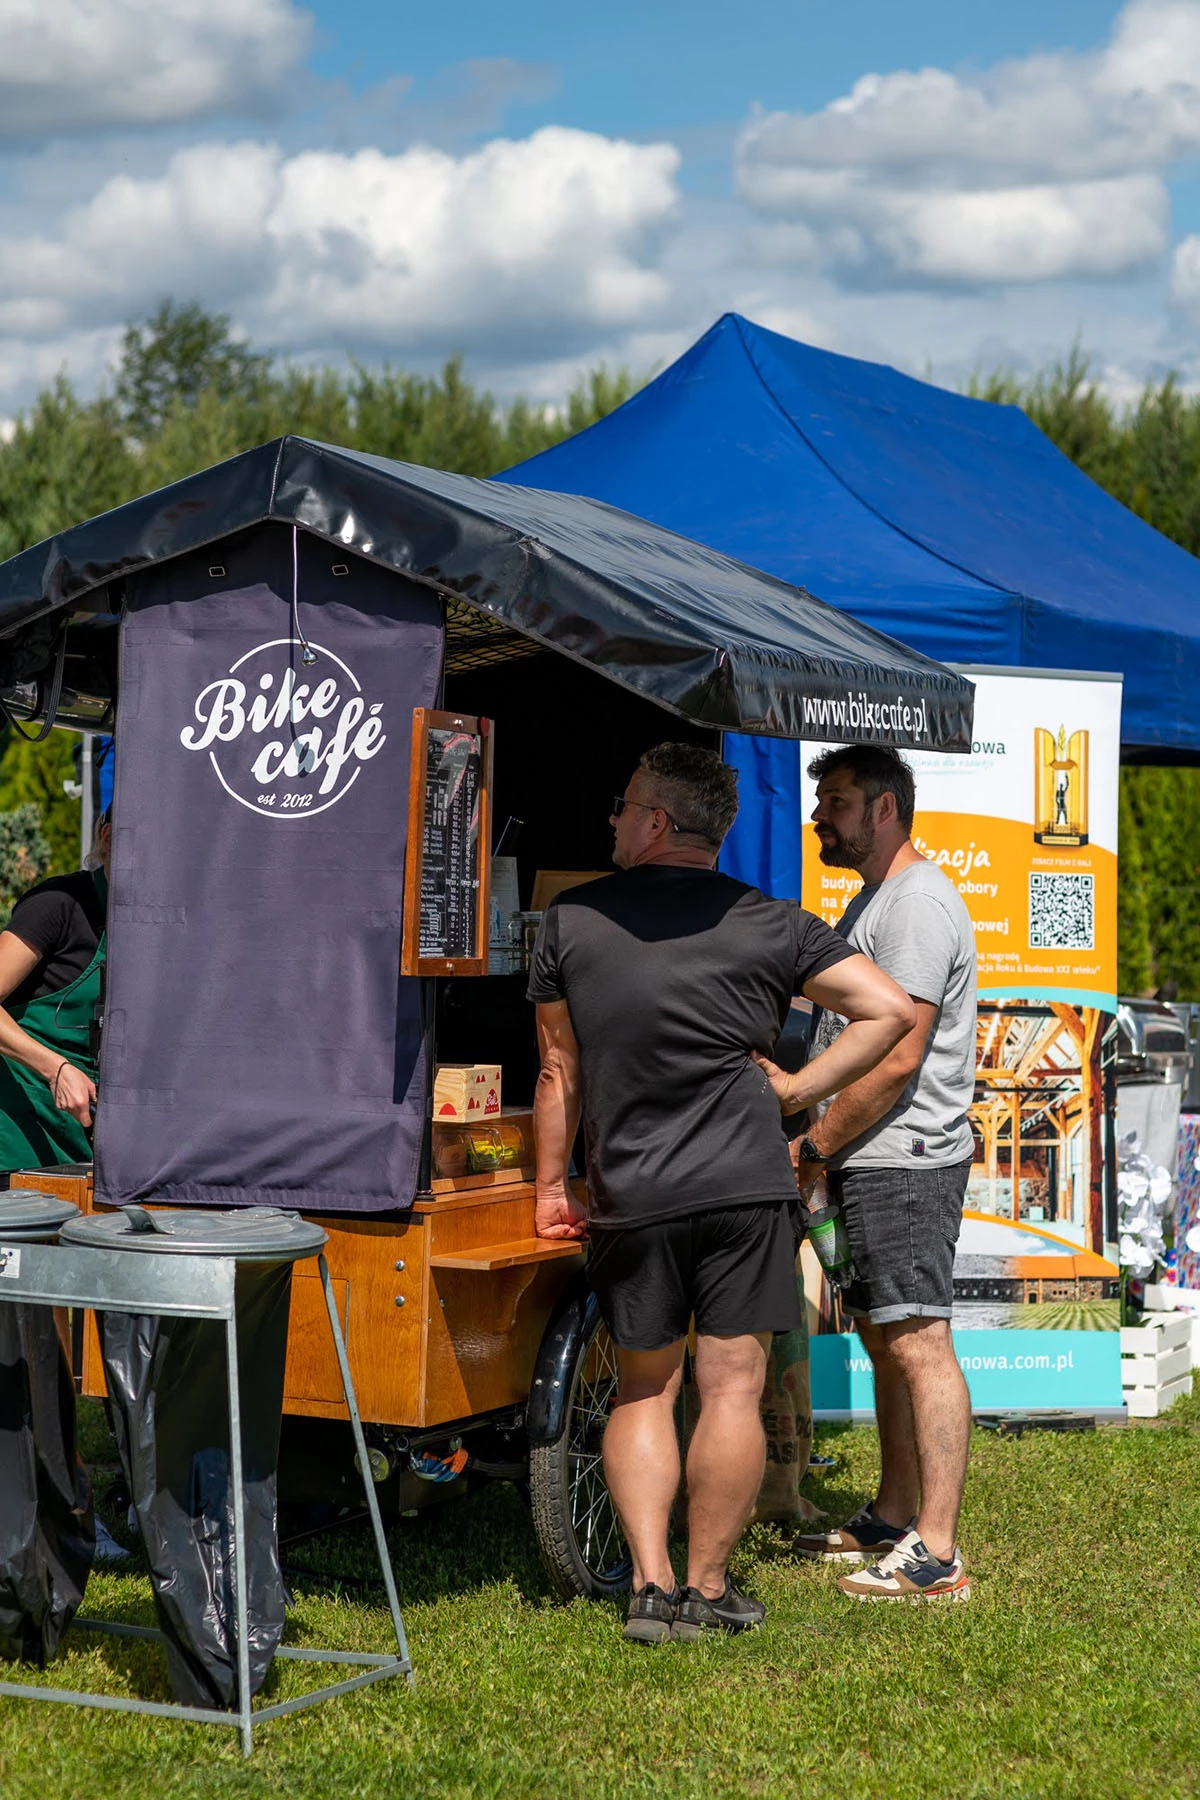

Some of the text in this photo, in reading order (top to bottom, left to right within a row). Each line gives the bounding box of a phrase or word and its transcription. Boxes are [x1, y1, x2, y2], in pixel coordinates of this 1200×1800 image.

[180, 667, 340, 750] Bike
[803, 692, 928, 741] www.bikecafe.pl
[251, 697, 387, 795] café
[971, 741, 1006, 755] owa
[257, 793, 313, 808] est 2012
[821, 875, 998, 897] budyn obory
[821, 897, 837, 908] na
